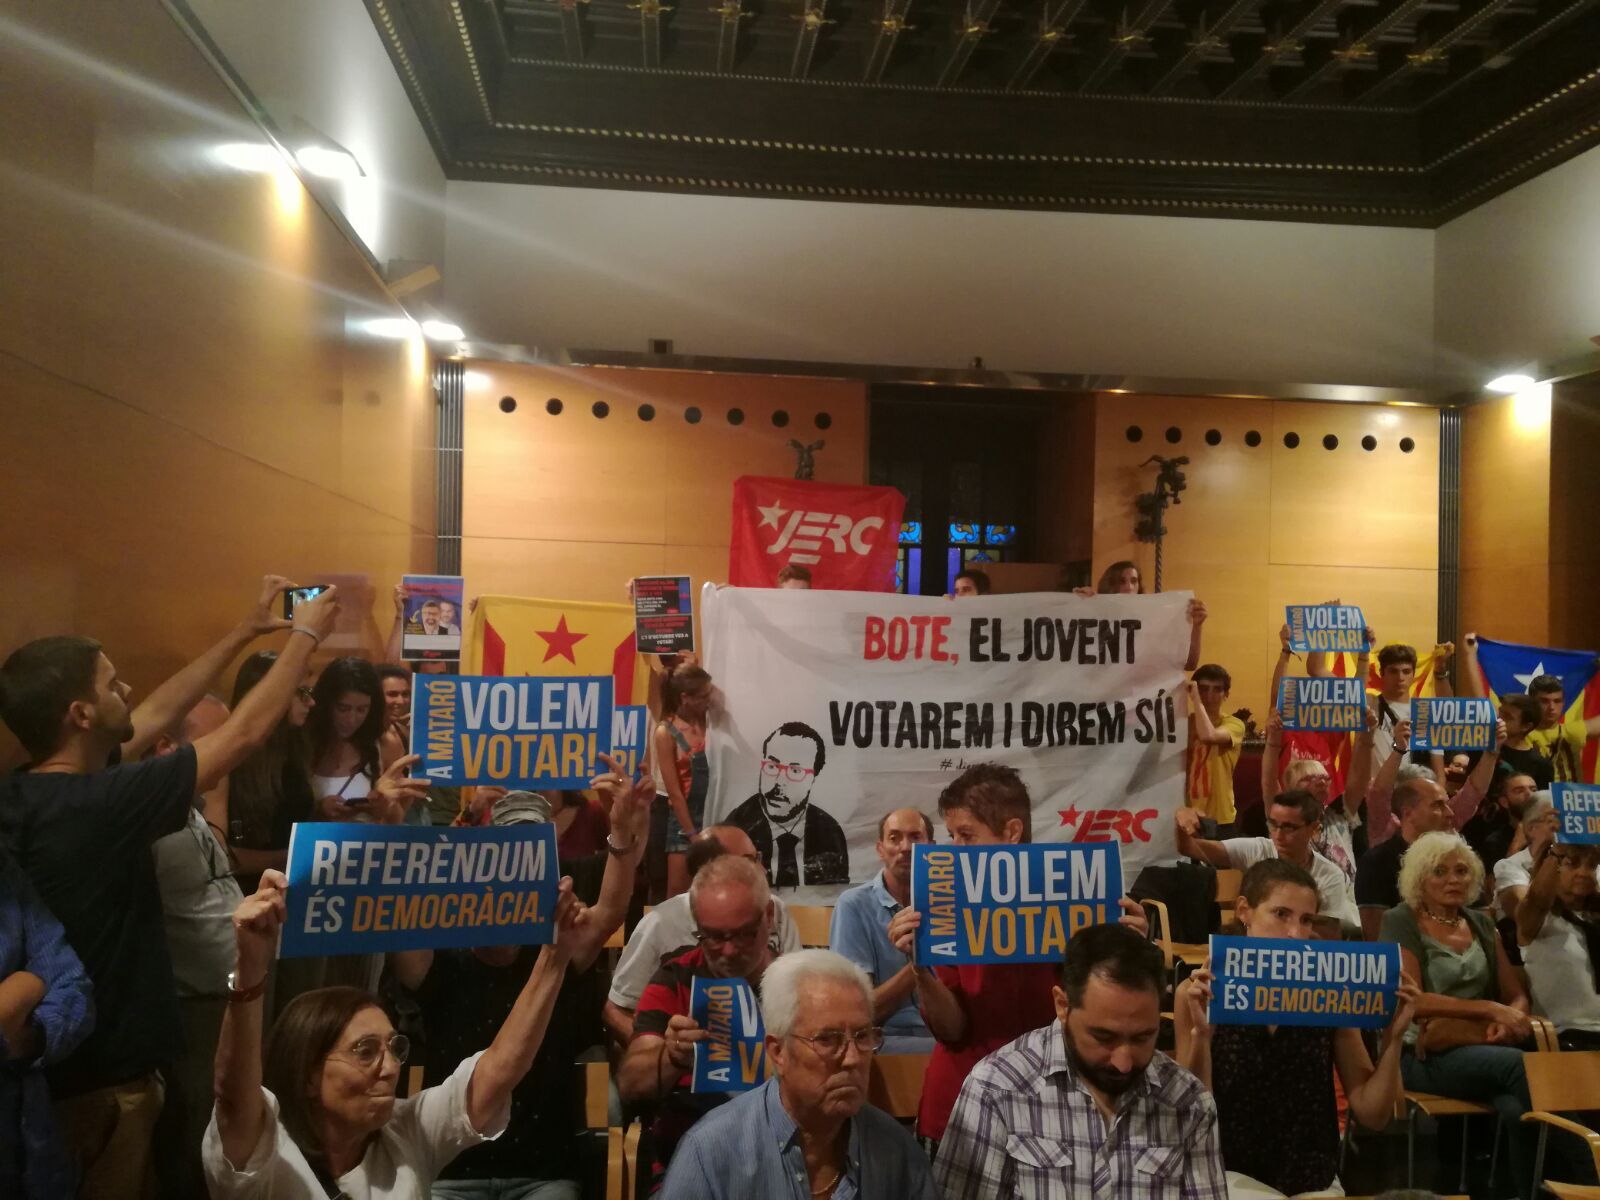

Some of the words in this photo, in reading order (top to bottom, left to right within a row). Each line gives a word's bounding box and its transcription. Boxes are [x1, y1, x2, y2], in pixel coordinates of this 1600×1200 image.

[767, 510, 885, 565] JERC
[1304, 607, 1362, 629] VOLEM
[863, 615, 959, 665] BOTE,
[969, 617, 1010, 663] EL
[1017, 617, 1142, 665] JOVENT
[1306, 629, 1364, 650] VOTAR!
[461, 682, 600, 730] VOLEM
[1298, 680, 1361, 704] VOLEM
[424, 680, 456, 761] MATARÓ
[829, 701, 994, 749] VOTAREM
[1003, 702, 1013, 748] I
[1022, 701, 1126, 748] DIREM
[1134, 688, 1177, 744] SÍ!
[1298, 704, 1362, 728] VOTAR!
[1431, 700, 1491, 724] VOLEM
[1430, 725, 1490, 747] VOTAR!
[426, 765, 453, 779] A
[460, 732, 598, 780] VOTAR!
[1071, 809, 1159, 843] JERC
[1565, 812, 1584, 834] ÉS
[310, 834, 546, 886] REFERÈNDUM
[959, 849, 1106, 904] VOLEM
[303, 889, 345, 934] ÉS
[351, 886, 545, 932] DEMOCRÀCIA.
[922, 851, 957, 937] MATARÓ
[931, 941, 957, 957] A
[1224, 944, 1387, 985] REFERÈNDUM
[1223, 979, 1249, 1011] ÉS
[1254, 985, 1389, 1016] DEMOCRÀCIA.
[702, 985, 733, 1062] MATARÓ
[707, 1067, 730, 1082] A
